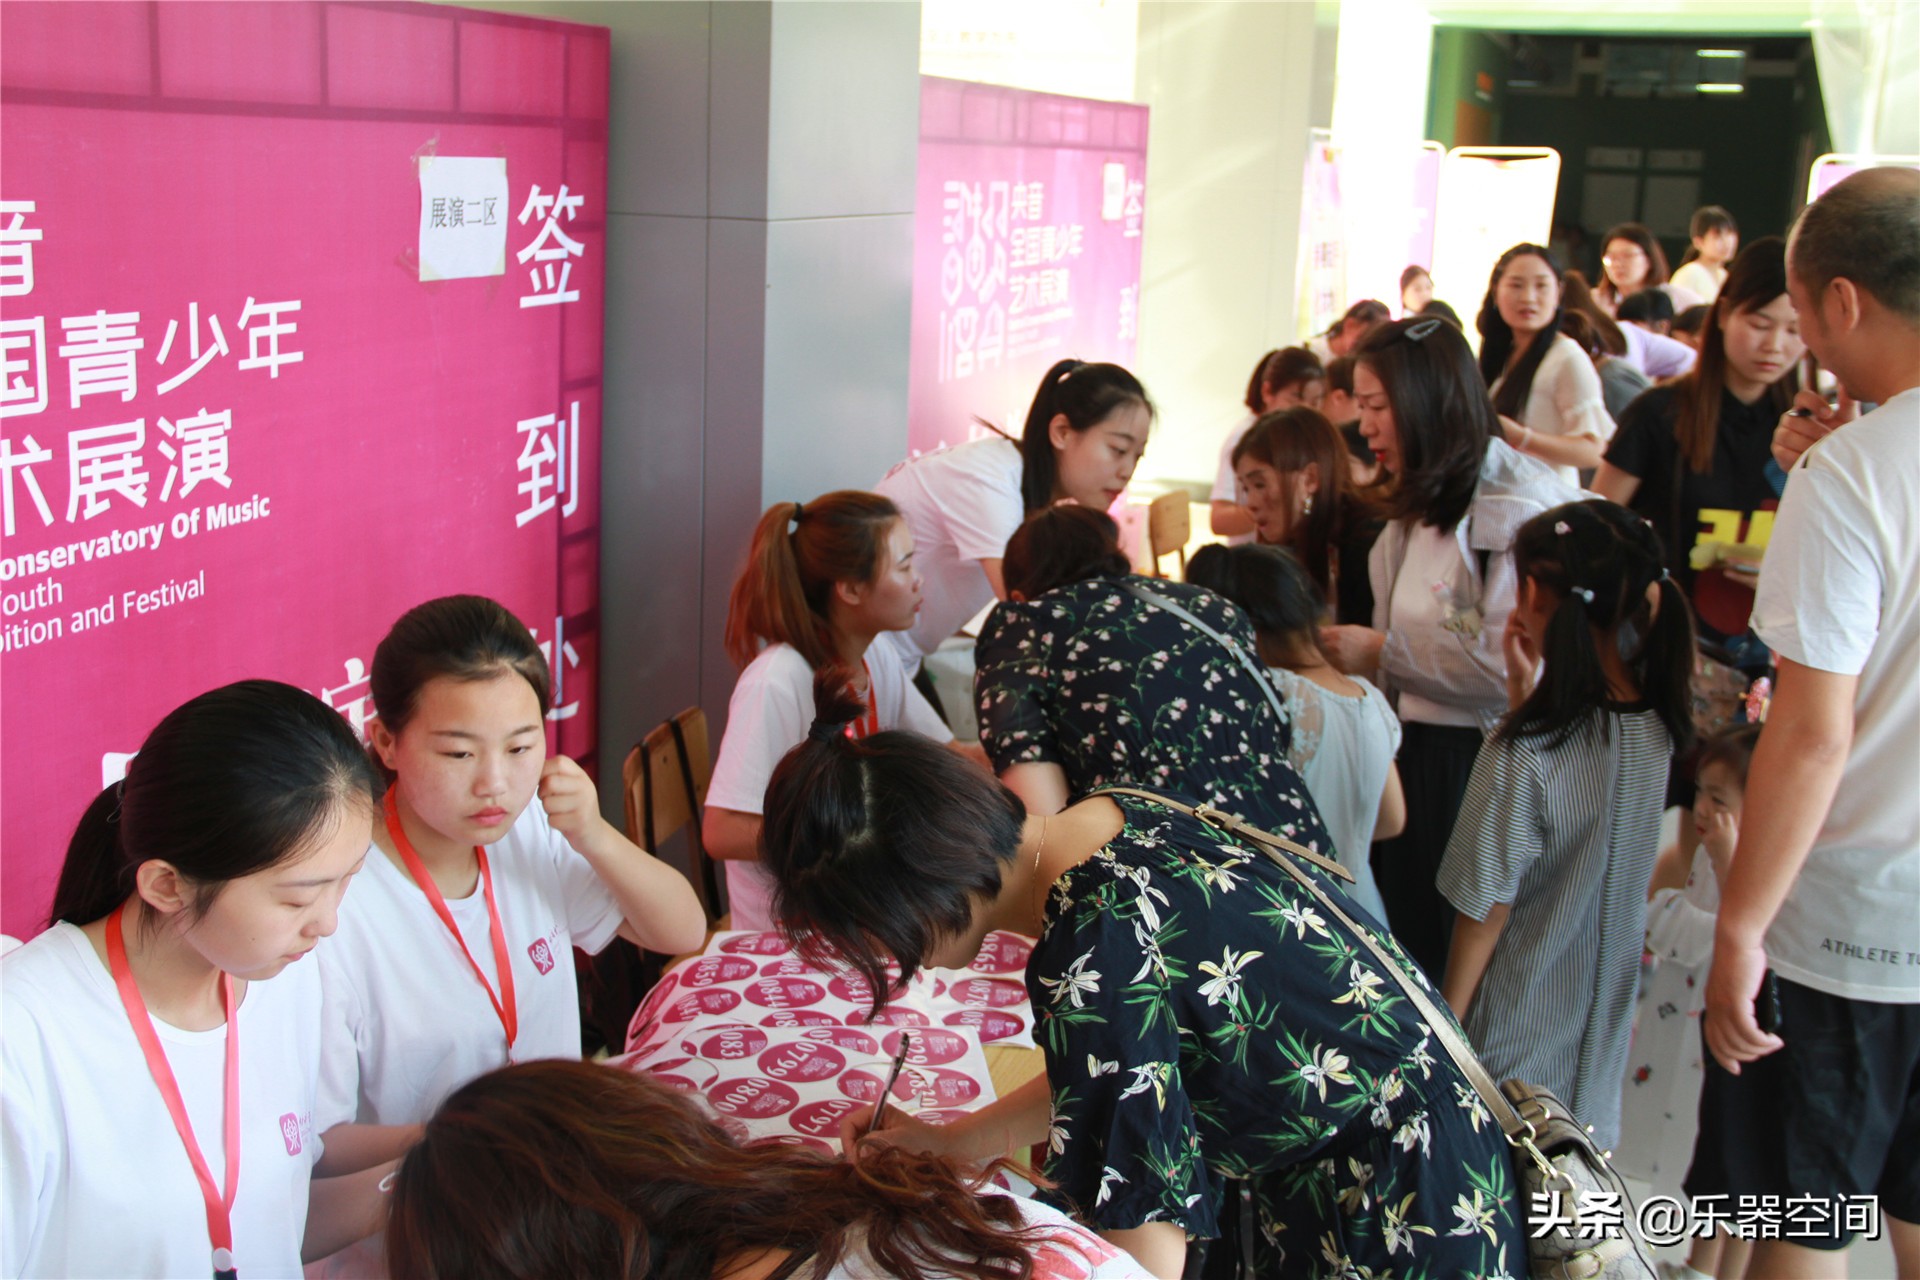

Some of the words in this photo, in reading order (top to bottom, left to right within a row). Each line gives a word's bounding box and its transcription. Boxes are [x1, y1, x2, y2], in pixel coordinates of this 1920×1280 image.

[430, 196, 498, 229] 展演二区
[1010, 224, 1084, 268] 全国青少年
[171, 507, 200, 539] Of
[206, 494, 270, 531] Music
[0, 576, 63, 617] outh
[70, 595, 115, 633] and
[123, 569, 205, 618] Festival
[1820, 937, 1900, 967] ATHLETE
[766, 1042, 818, 1077] 0799
[714, 1078, 770, 1113] 0800
[799, 1100, 852, 1133] 0797
